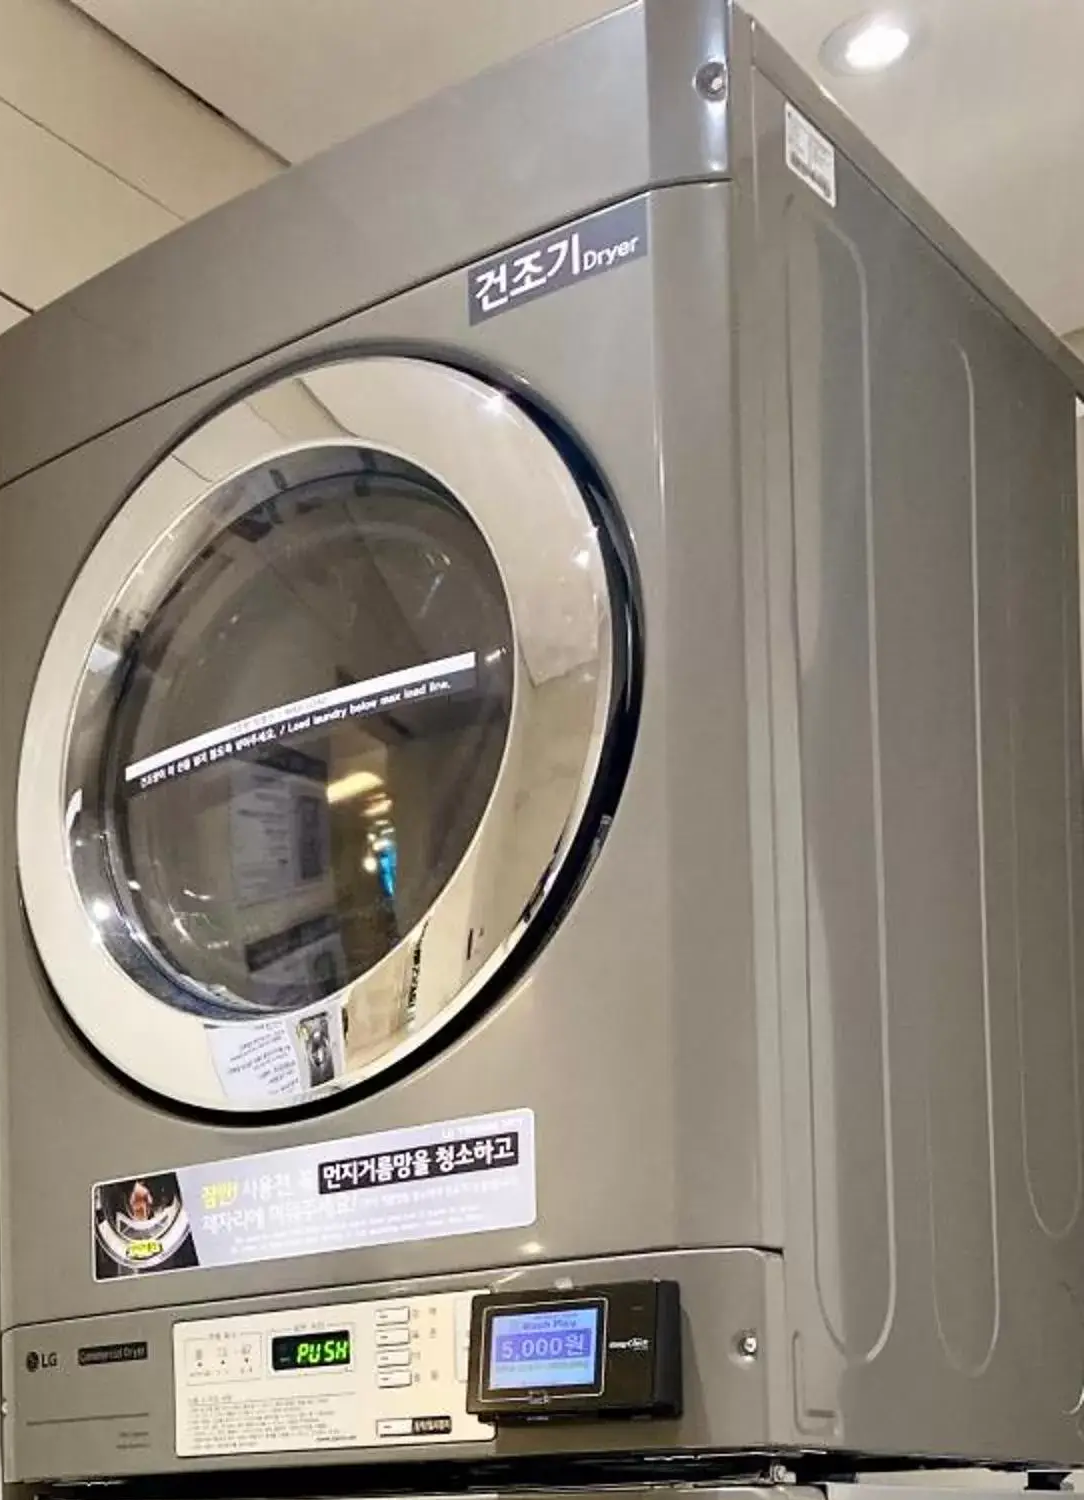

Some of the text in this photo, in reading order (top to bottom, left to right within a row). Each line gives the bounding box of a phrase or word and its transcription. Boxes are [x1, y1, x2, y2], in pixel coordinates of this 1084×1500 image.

[475, 232, 639, 313] 건조기 Dryer
[323, 1149, 431, 1190] 먼지거름망을
[436, 1137, 514, 1172] 청소하고
[41, 1352, 58, 1368] LG
[297, 1341, 349, 1364] PUSH
[501, 1333, 585, 1360] 5,000원
